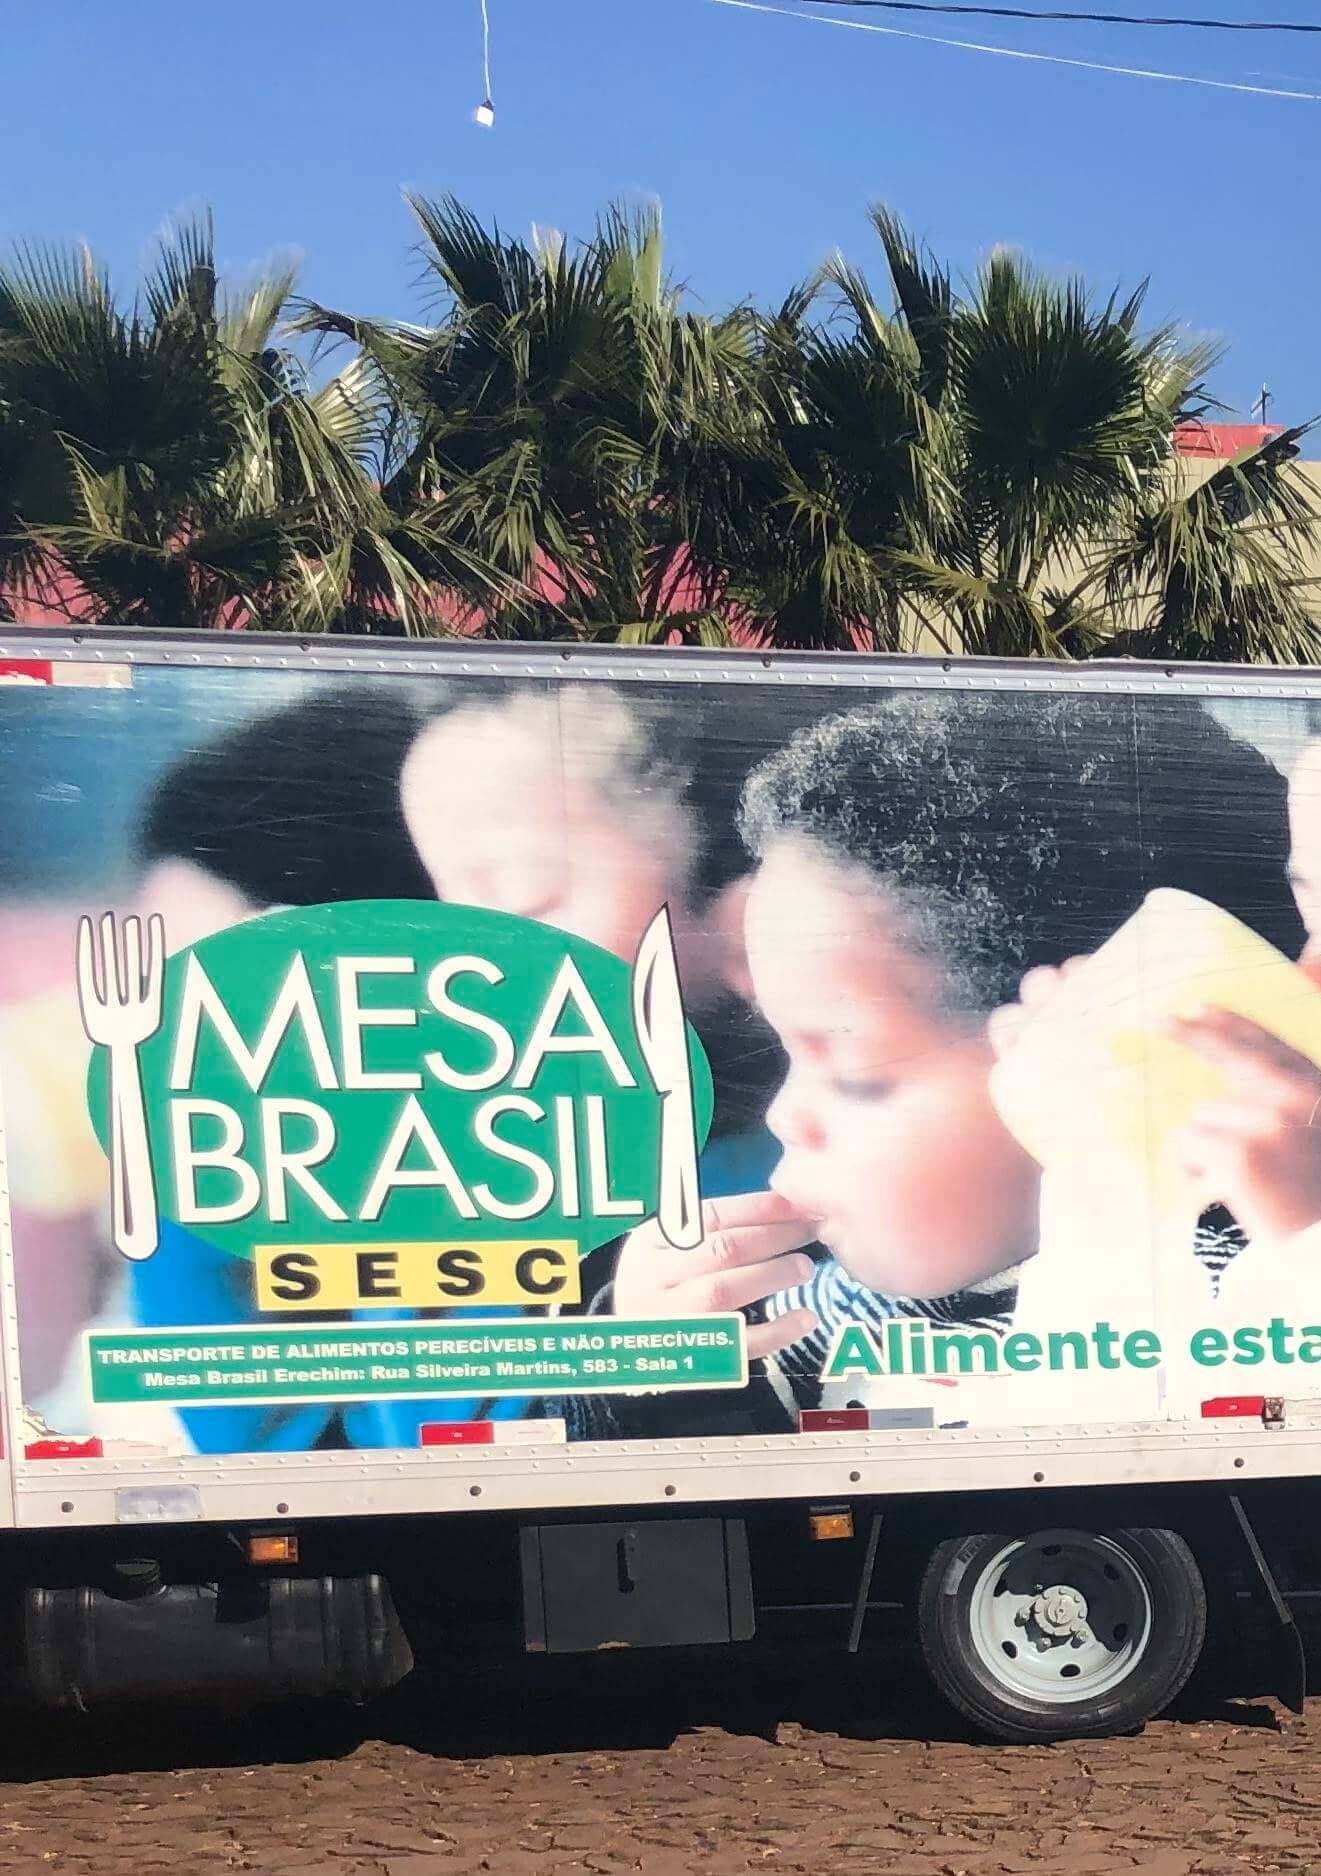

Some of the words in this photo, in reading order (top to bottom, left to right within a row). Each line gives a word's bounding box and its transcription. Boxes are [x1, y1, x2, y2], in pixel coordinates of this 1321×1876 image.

[169, 949, 638, 1093] MESA
[170, 1093, 645, 1223] BRASIL
[269, 1247, 569, 1301] SESC
[97, 1345, 245, 1364] TRANSPORTE
[252, 1345, 280, 1360] DE
[286, 1341, 409, 1359] ALIMENTOS
[415, 1335, 537, 1355] PERECÍVEIS
[543, 1338, 556, 1351] E
[562, 1334, 605, 1351] NÃO
[610, 1330, 734, 1349] PERECÍVEIS.
[144, 1372, 200, 1387] Mesa
[207, 1369, 268, 1385] Brasil
[274, 1366, 365, 1383] Erechim:
[371, 1364, 410, 1380] Rua
[415, 1361, 490, 1379] Silveira
[496, 1360, 577, 1377] Martins,
[583, 1359, 619, 1373] 583
[635, 1357, 677, 1372] Sala
[684, 1356, 693, 1369] 1
[826, 1321, 1162, 1377] Alimente
